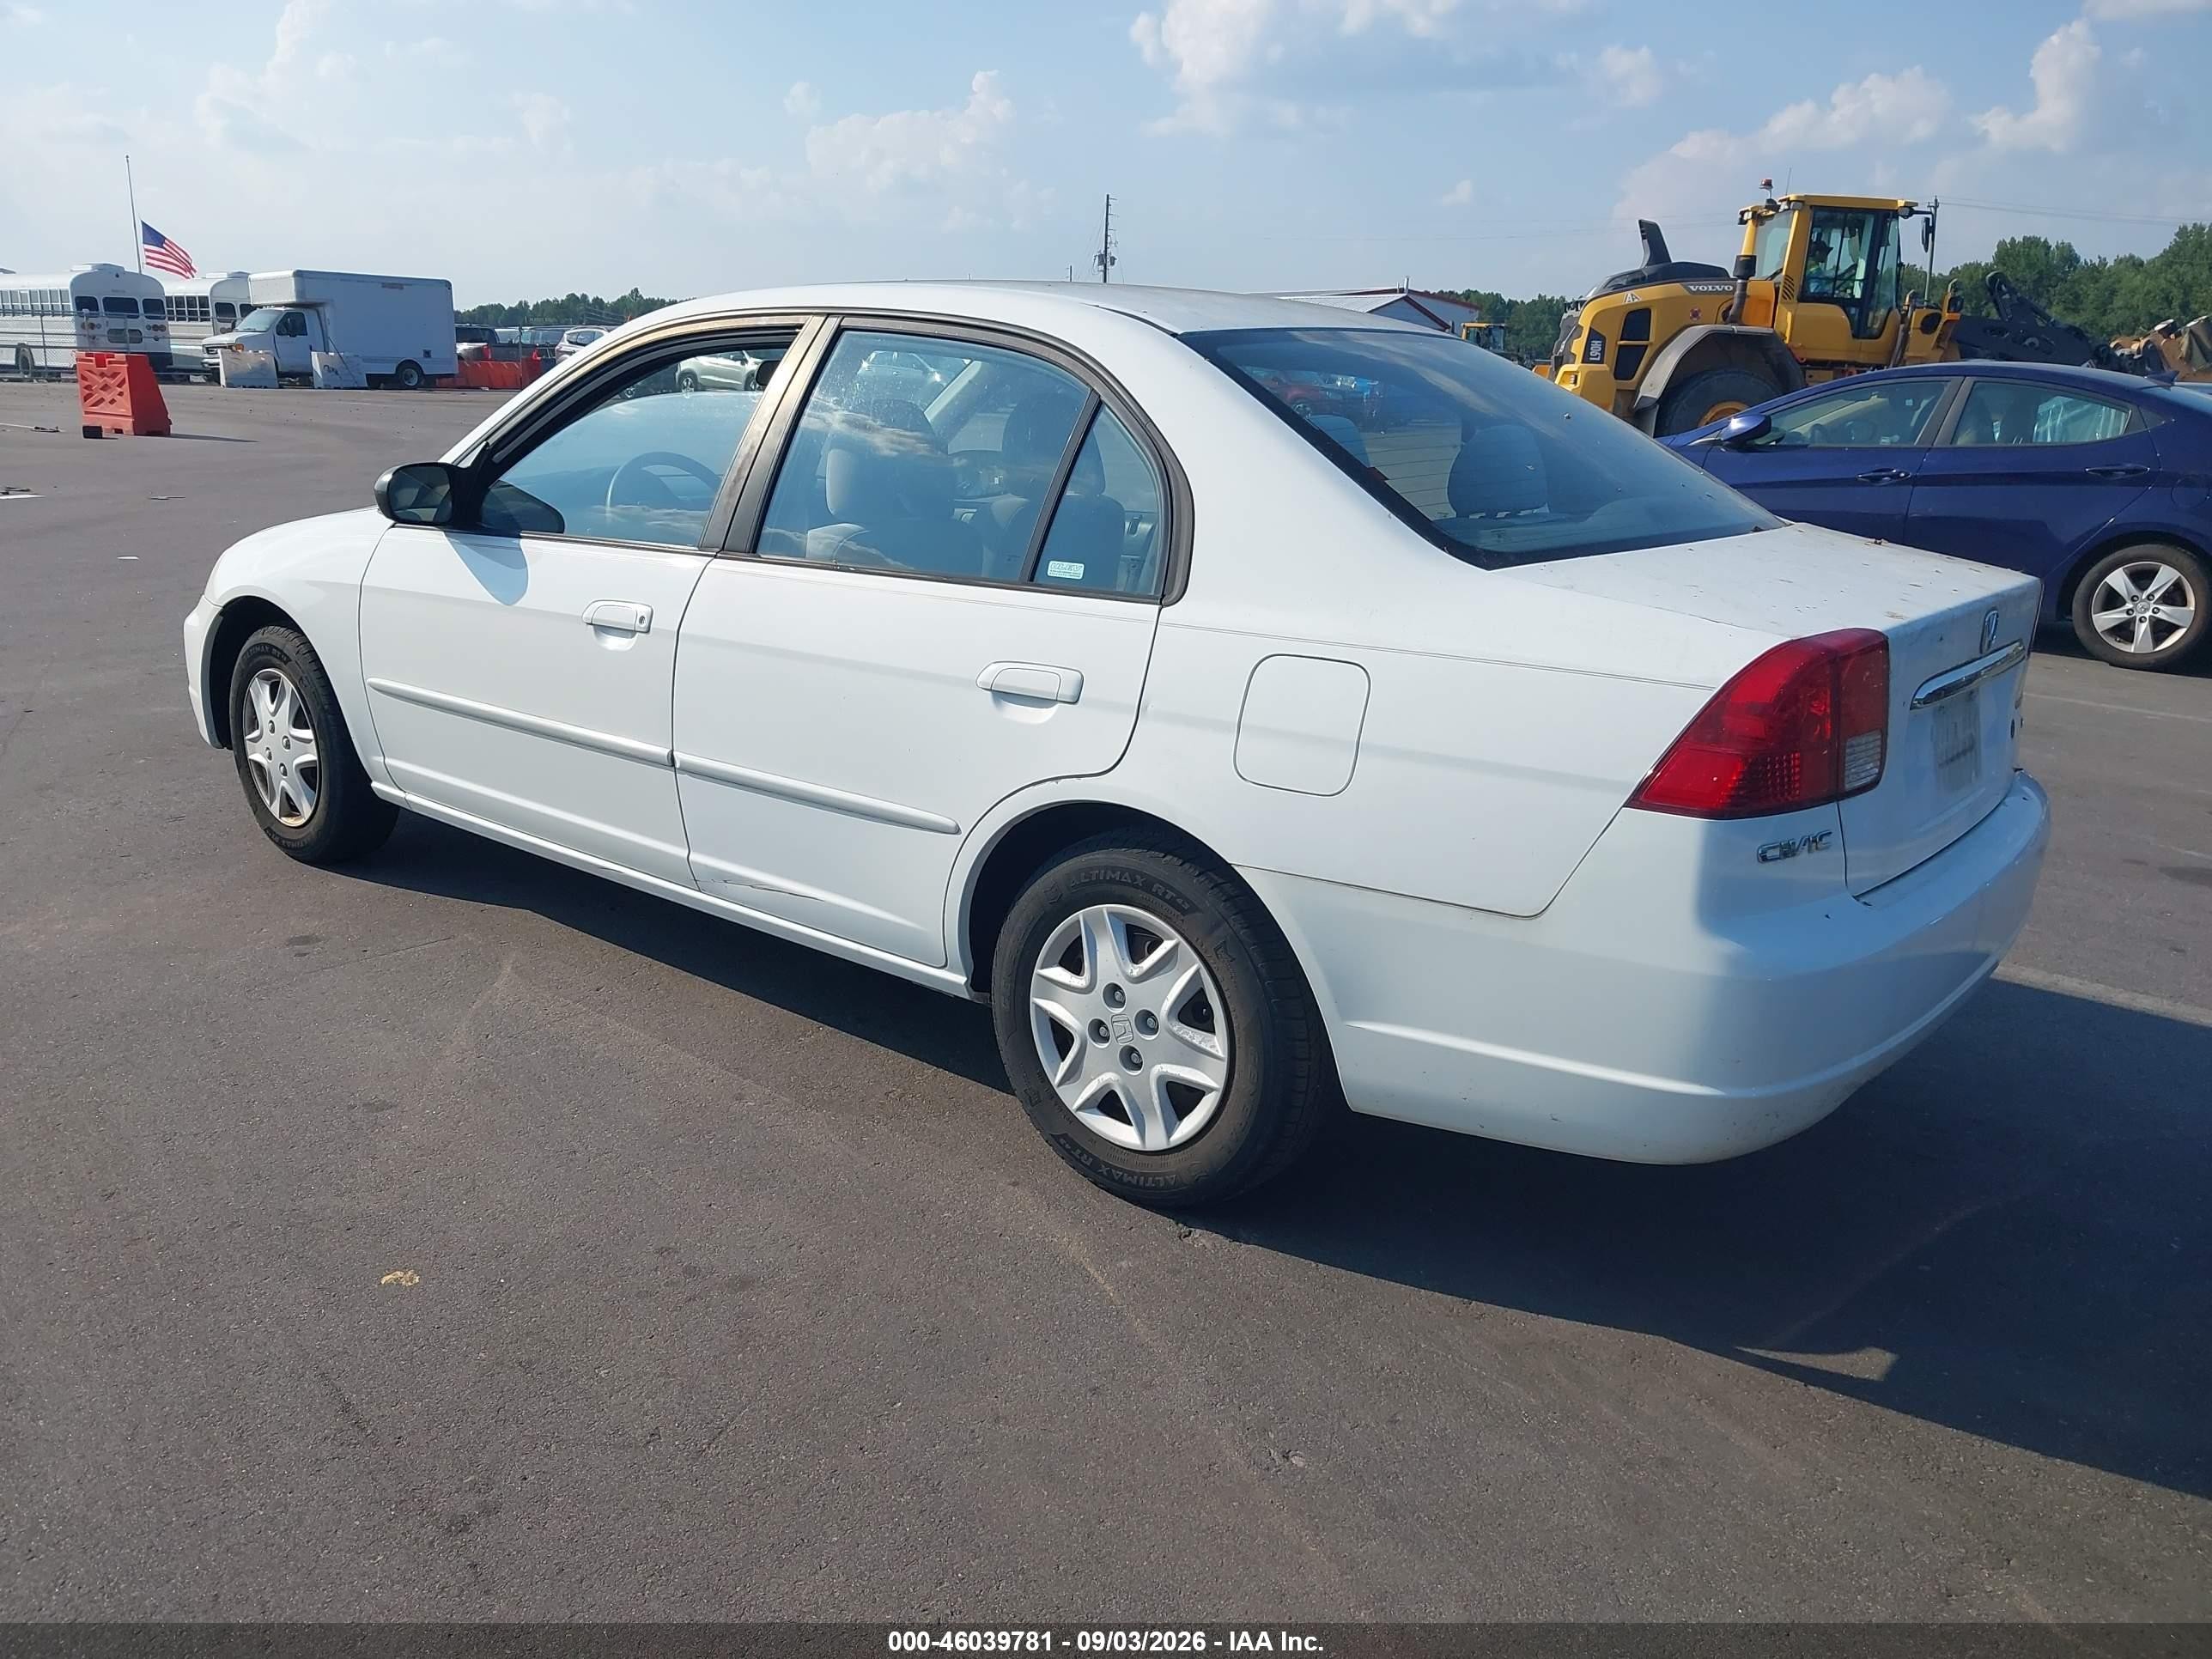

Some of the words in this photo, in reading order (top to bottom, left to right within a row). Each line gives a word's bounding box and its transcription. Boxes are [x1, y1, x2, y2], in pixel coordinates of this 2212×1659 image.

[1589, 340, 1602, 361] L90H
[1757, 830, 1832, 862] CIVIC
[1071, 870, 1147, 887] ALTIMAX
